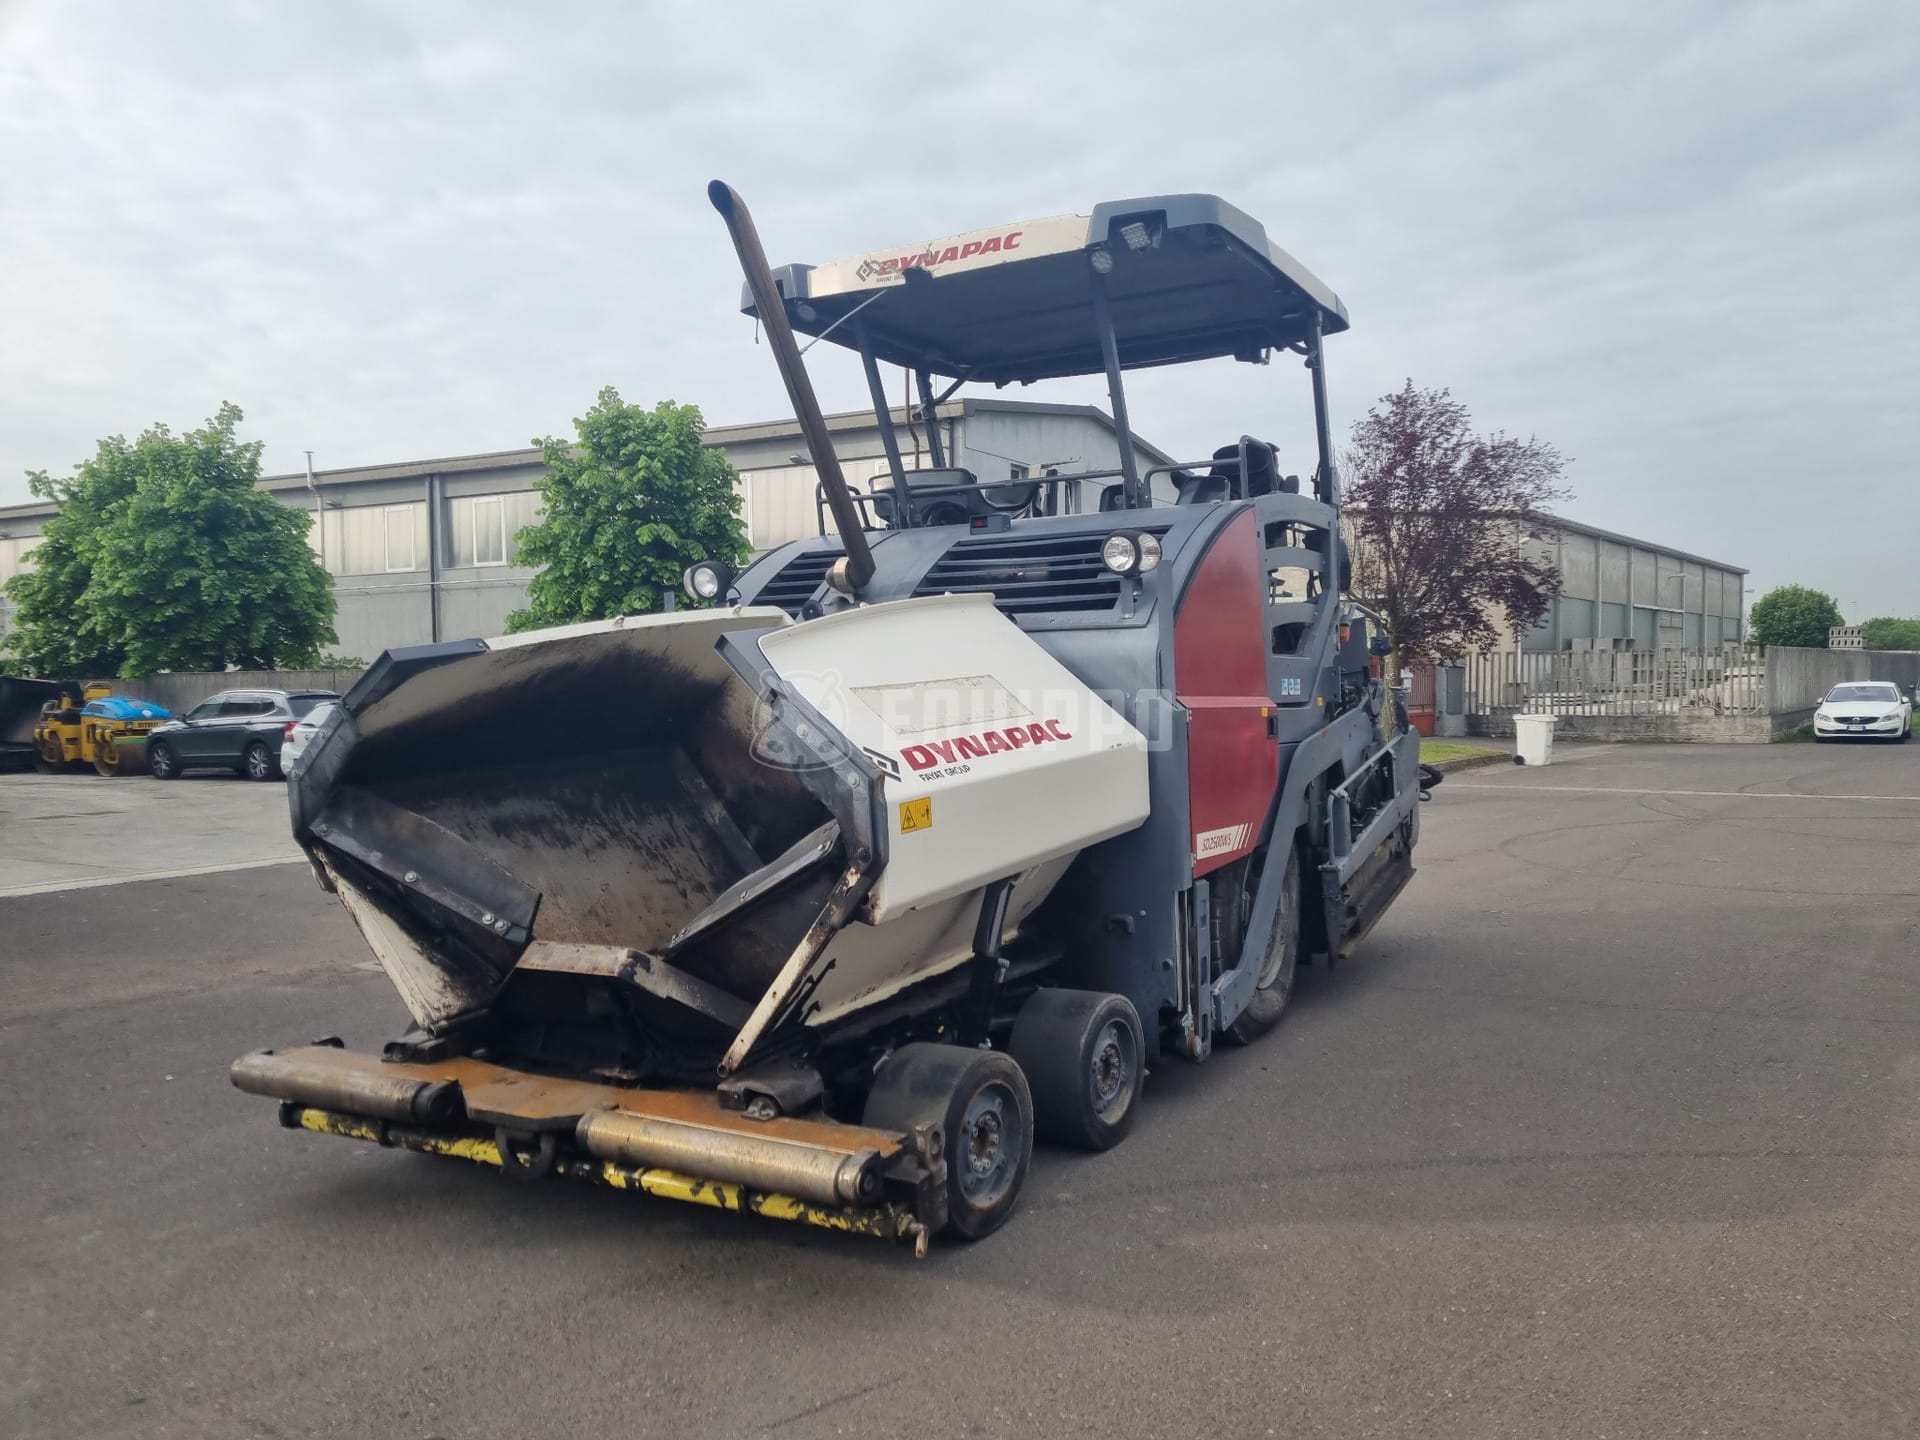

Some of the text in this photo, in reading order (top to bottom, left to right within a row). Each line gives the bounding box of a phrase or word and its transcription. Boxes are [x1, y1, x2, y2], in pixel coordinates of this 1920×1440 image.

[878, 232, 1023, 276] DYNAPAC
[900, 719, 1073, 771] DYNAPAC
[919, 764, 971, 782] FAYAT GROUP
